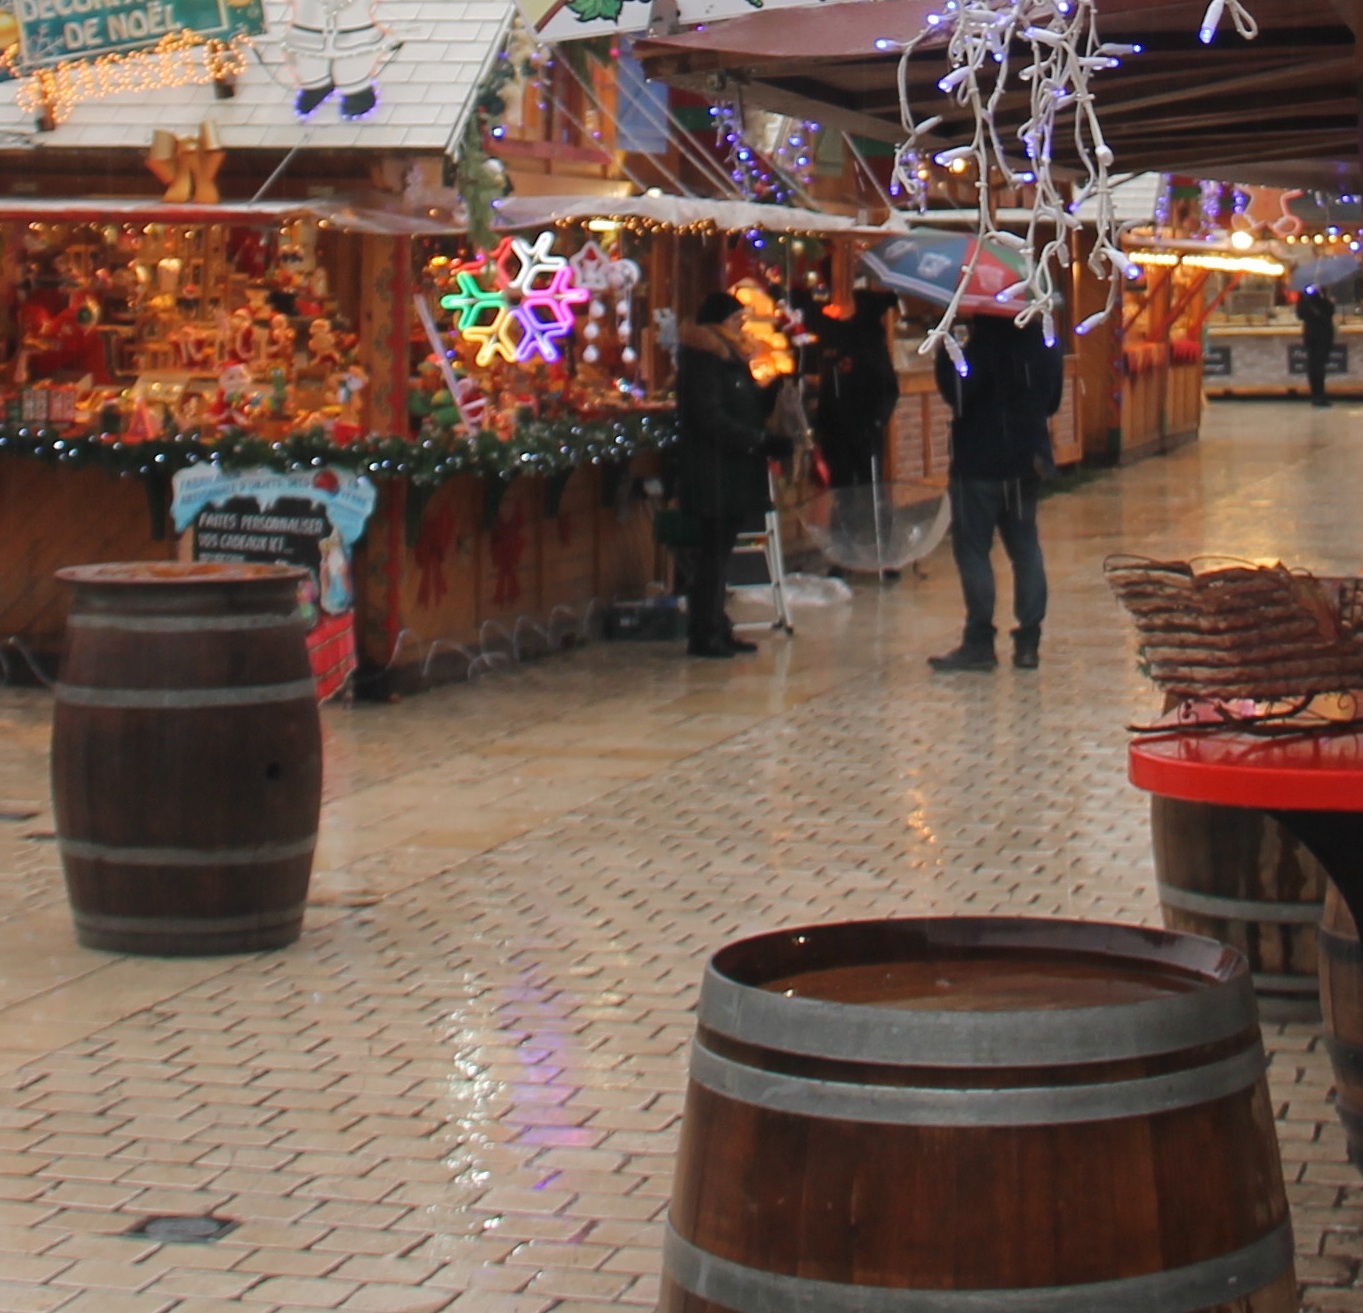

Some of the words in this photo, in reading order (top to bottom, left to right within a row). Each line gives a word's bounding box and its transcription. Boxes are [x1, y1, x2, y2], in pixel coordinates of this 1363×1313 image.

[63, 17, 103, 50] DE
[106, 0, 182, 41] NOËL
[197, 512, 237, 529] FAITES
